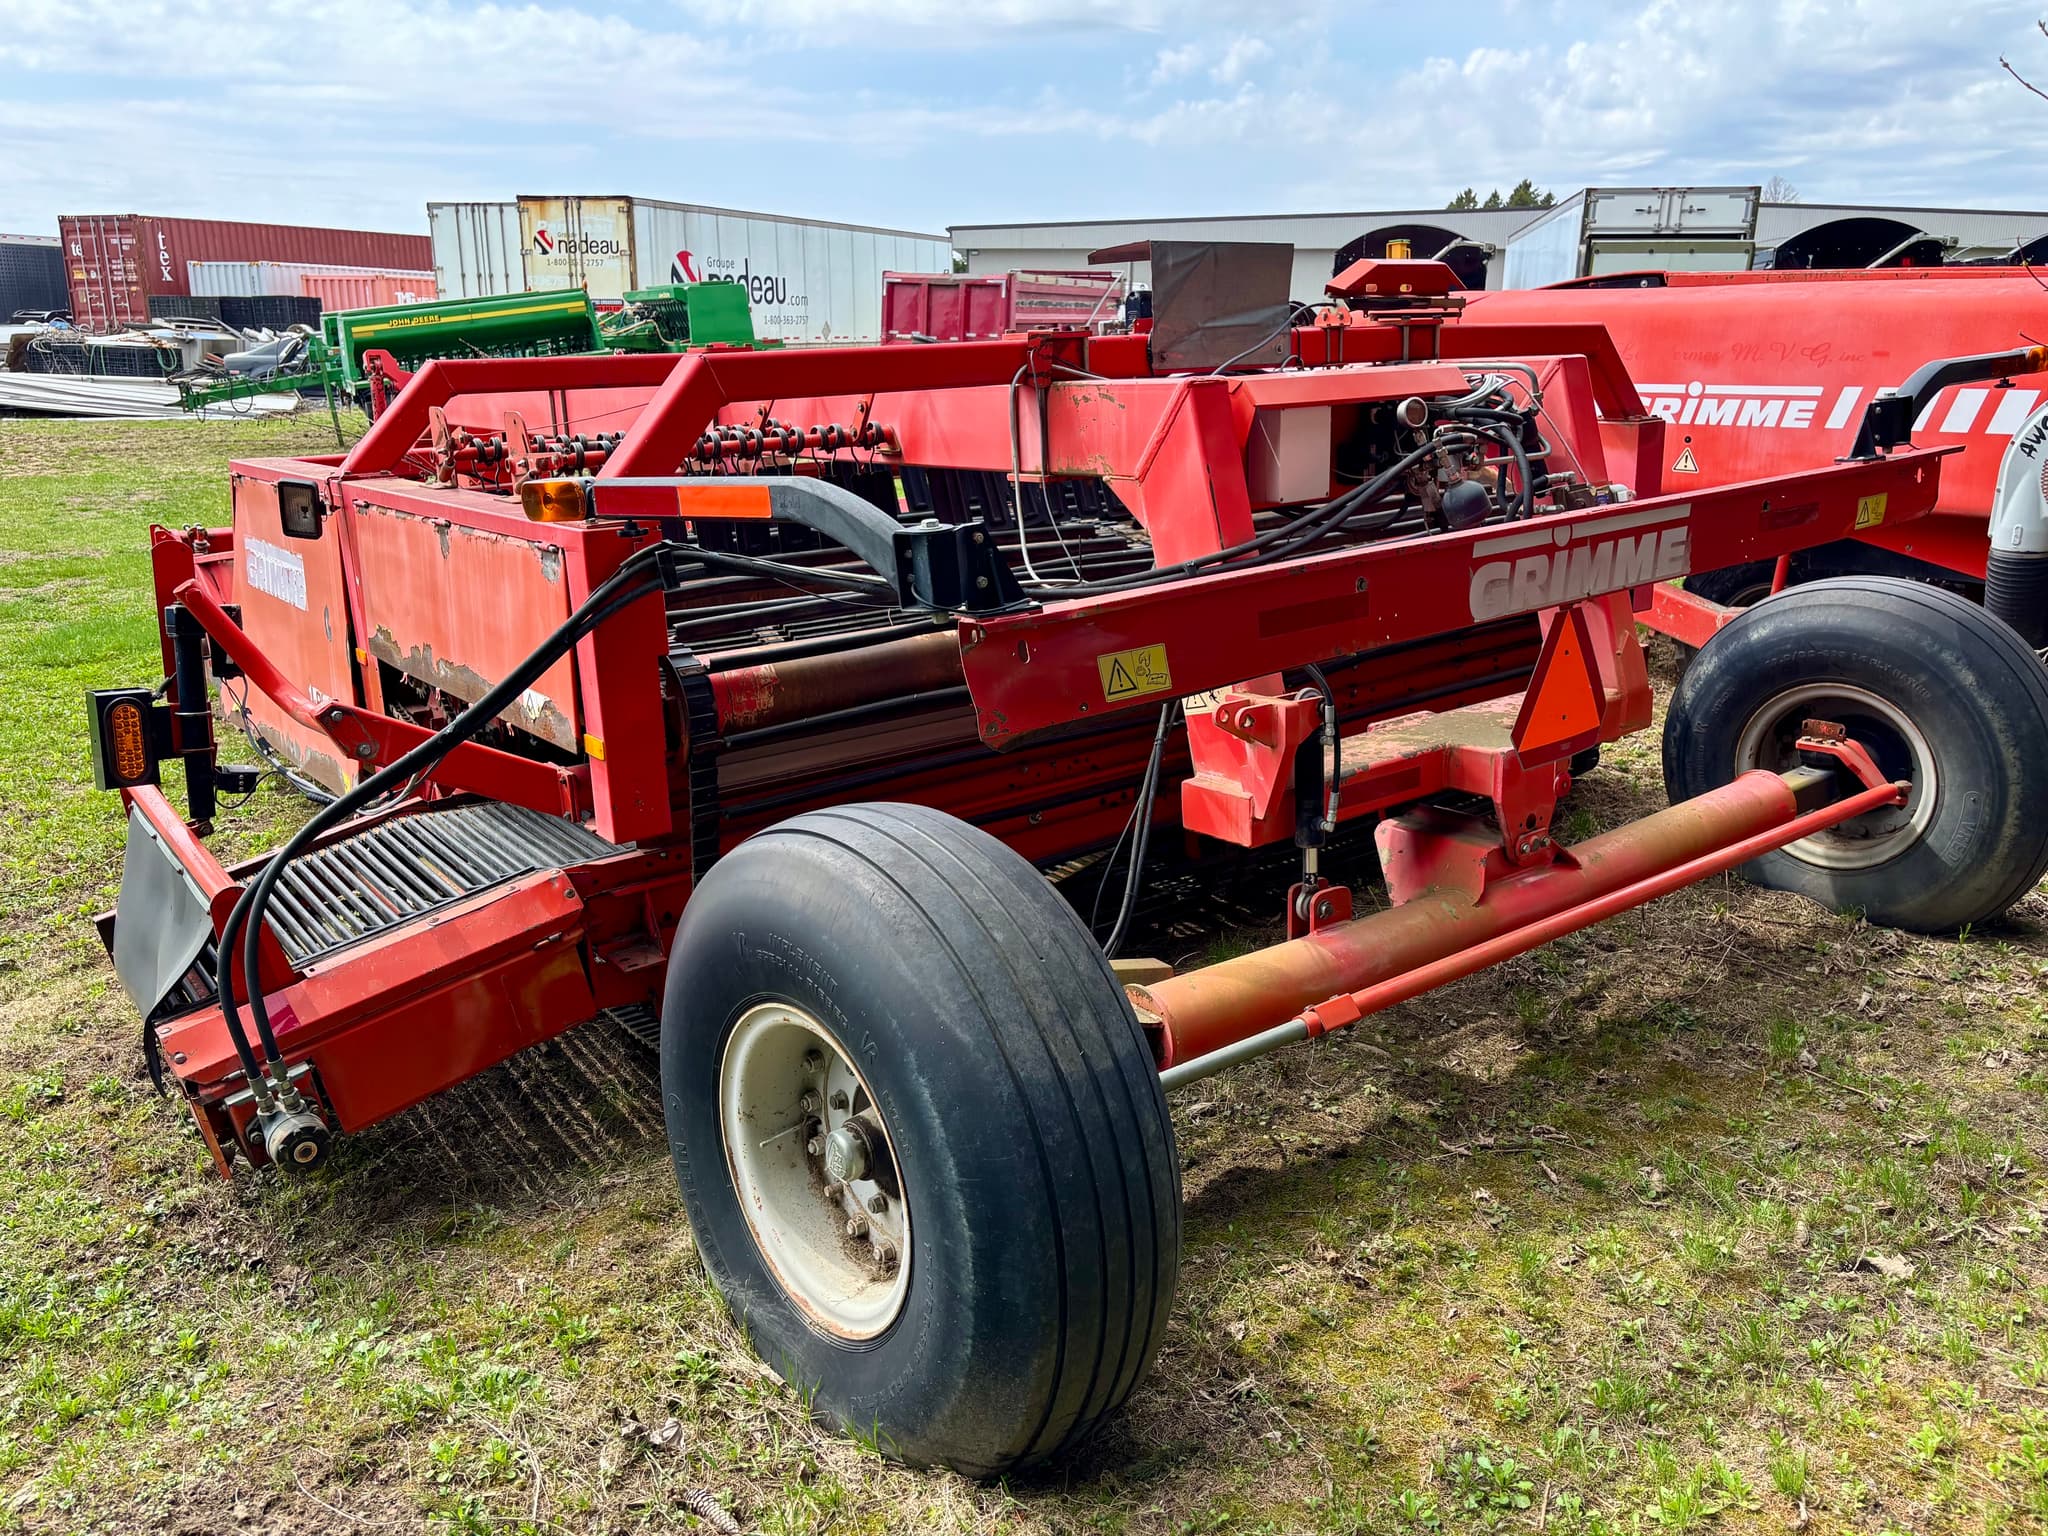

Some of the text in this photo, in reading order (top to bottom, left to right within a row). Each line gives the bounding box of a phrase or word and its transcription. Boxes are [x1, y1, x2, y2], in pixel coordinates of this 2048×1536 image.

[558, 232, 620, 255] nadeau
[707, 256, 735, 269] Groupe
[389, 314, 441, 328] JOHN DEERE
[1469, 524, 1692, 623] GRIMME
